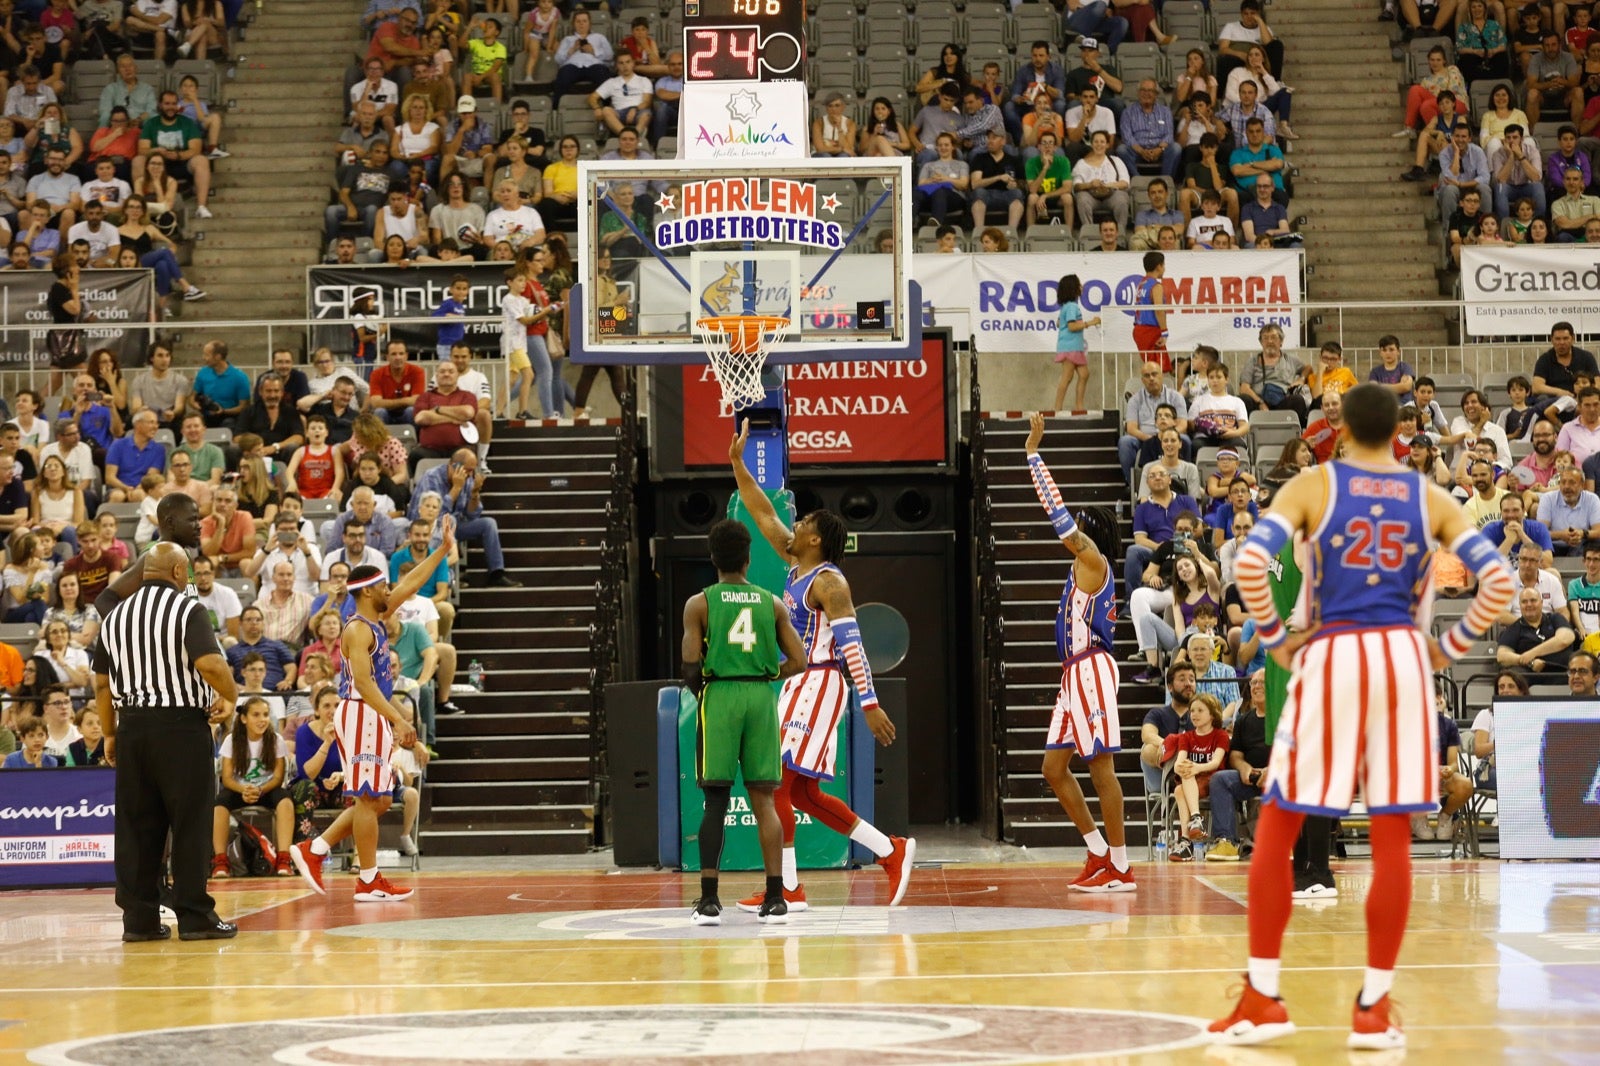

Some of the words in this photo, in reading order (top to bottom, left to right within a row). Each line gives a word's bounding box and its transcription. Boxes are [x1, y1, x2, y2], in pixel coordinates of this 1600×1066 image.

[690, 31, 756, 77] 24
[696, 122, 794, 147] Andalucía
[683, 178, 816, 217] HARLEM
[657, 215, 841, 248] GLOBETROTTERS
[979, 279, 1111, 313] RADO
[1162, 275, 1292, 314] MARCA
[1476, 306, 1497, 316] Está
[1499, 306, 1546, 317] pasando,
[1548, 306, 1559, 314] te
[980, 319, 1057, 331] GRANADA
[1233, 317, 1266, 329] 88.5
[756, 440, 766, 484] MONDO
[1340, 516, 1411, 572] 25
[720, 591, 762, 604] CHANDLER
[727, 607, 757, 653] 4
[3, 841, 46, 852] UNIFORM
[7, 851, 46, 860] PROVIDER
[59, 850, 106, 860] GLOBETROTTERS
[66, 841, 100, 851] HARLEM
